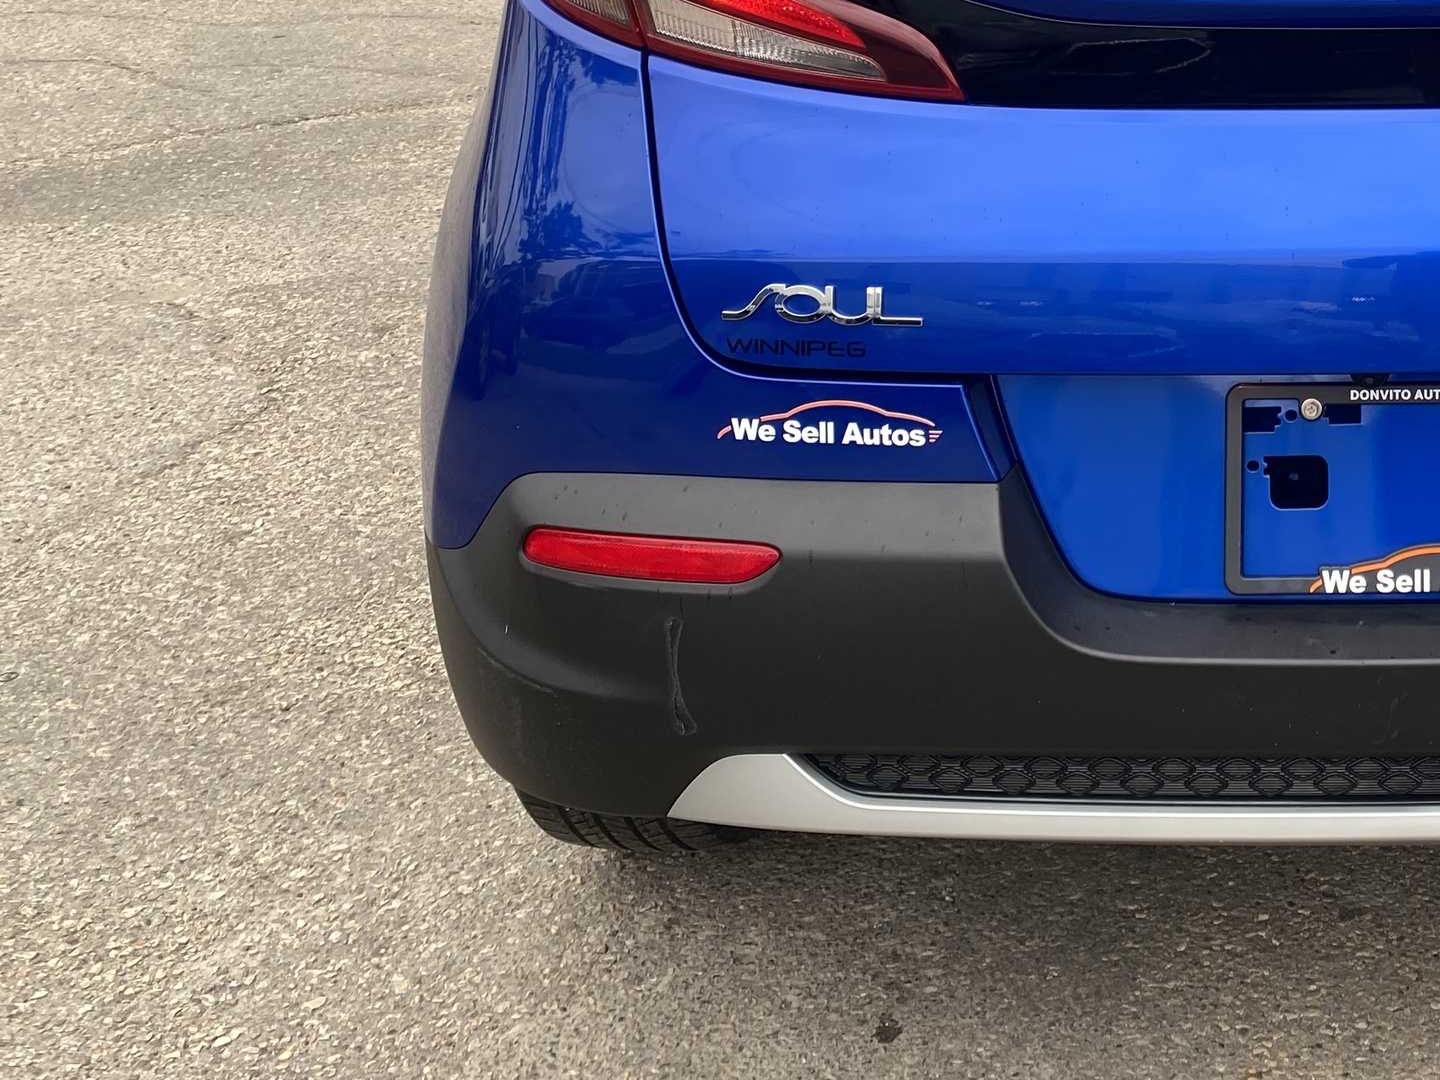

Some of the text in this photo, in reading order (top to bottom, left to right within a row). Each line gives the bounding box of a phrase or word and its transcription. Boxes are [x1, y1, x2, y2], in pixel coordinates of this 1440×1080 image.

[721, 283, 923, 327] SOUL
[725, 337, 867, 358] WINNIPEG
[1349, 389, 1411, 401] DONVITO
[730, 417, 926, 447] We Sell Autos
[1321, 570, 1367, 594] We
[1376, 569, 1431, 593] Sell
